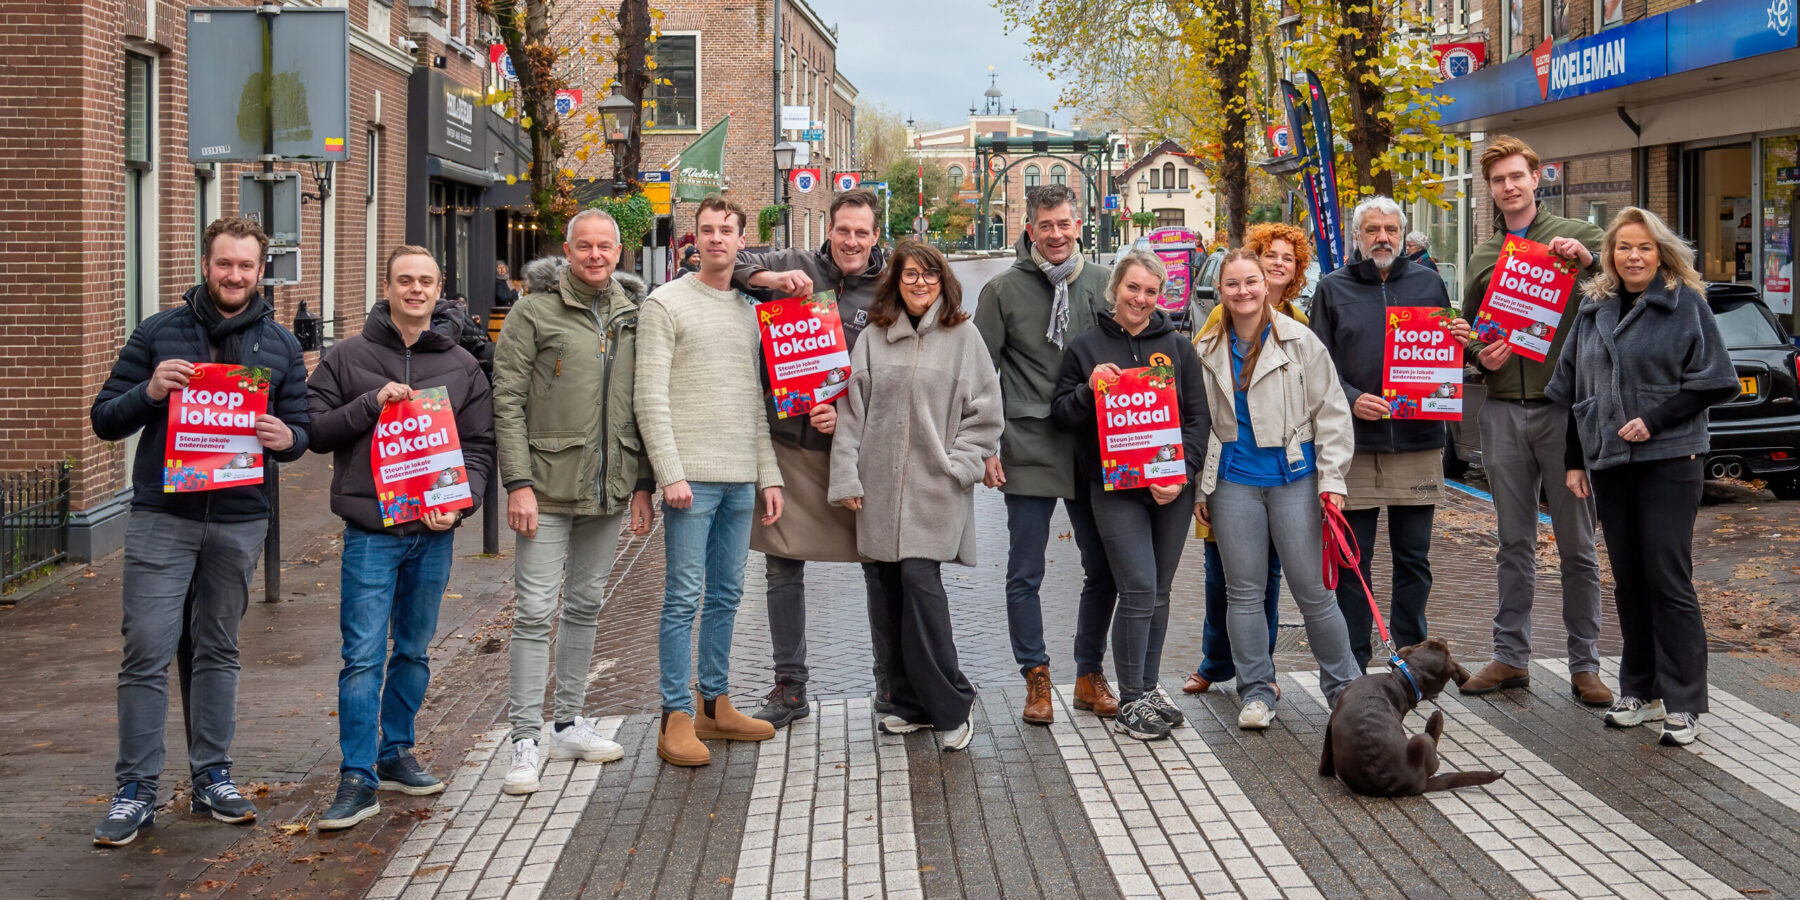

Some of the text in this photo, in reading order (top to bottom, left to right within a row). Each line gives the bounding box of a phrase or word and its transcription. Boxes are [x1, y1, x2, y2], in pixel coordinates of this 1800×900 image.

[1536, 54, 1550, 66] ELECTRO
[1551, 37, 1625, 90] KOELEMAN
[1537, 64, 1549, 76] WORLD
[1325, 209, 1340, 270] LACK
[1505, 255, 1555, 284] koop
[1499, 272, 1561, 304] lokaal
[1492, 300, 1529, 315] ondernemers
[1494, 295, 1510, 303] Steun
[1516, 301, 1533, 311] lokale
[770, 317, 822, 339] koop
[1394, 328, 1444, 346] koop
[772, 330, 837, 357] lokaal
[1393, 345, 1454, 361] lokaal
[778, 364, 795, 372] Steun
[802, 359, 820, 368] lokale
[779, 366, 818, 377] ondernemers
[182, 387, 244, 410] koop
[1105, 391, 1157, 409] koop
[181, 407, 256, 428] lokaal
[377, 414, 432, 438] koop
[1106, 406, 1170, 428] lokaal
[378, 428, 449, 458] lokaal
[1110, 440, 1150, 448] ondernemers
[384, 459, 431, 474] Steun je lokale
[385, 466, 428, 480] ondernemers
